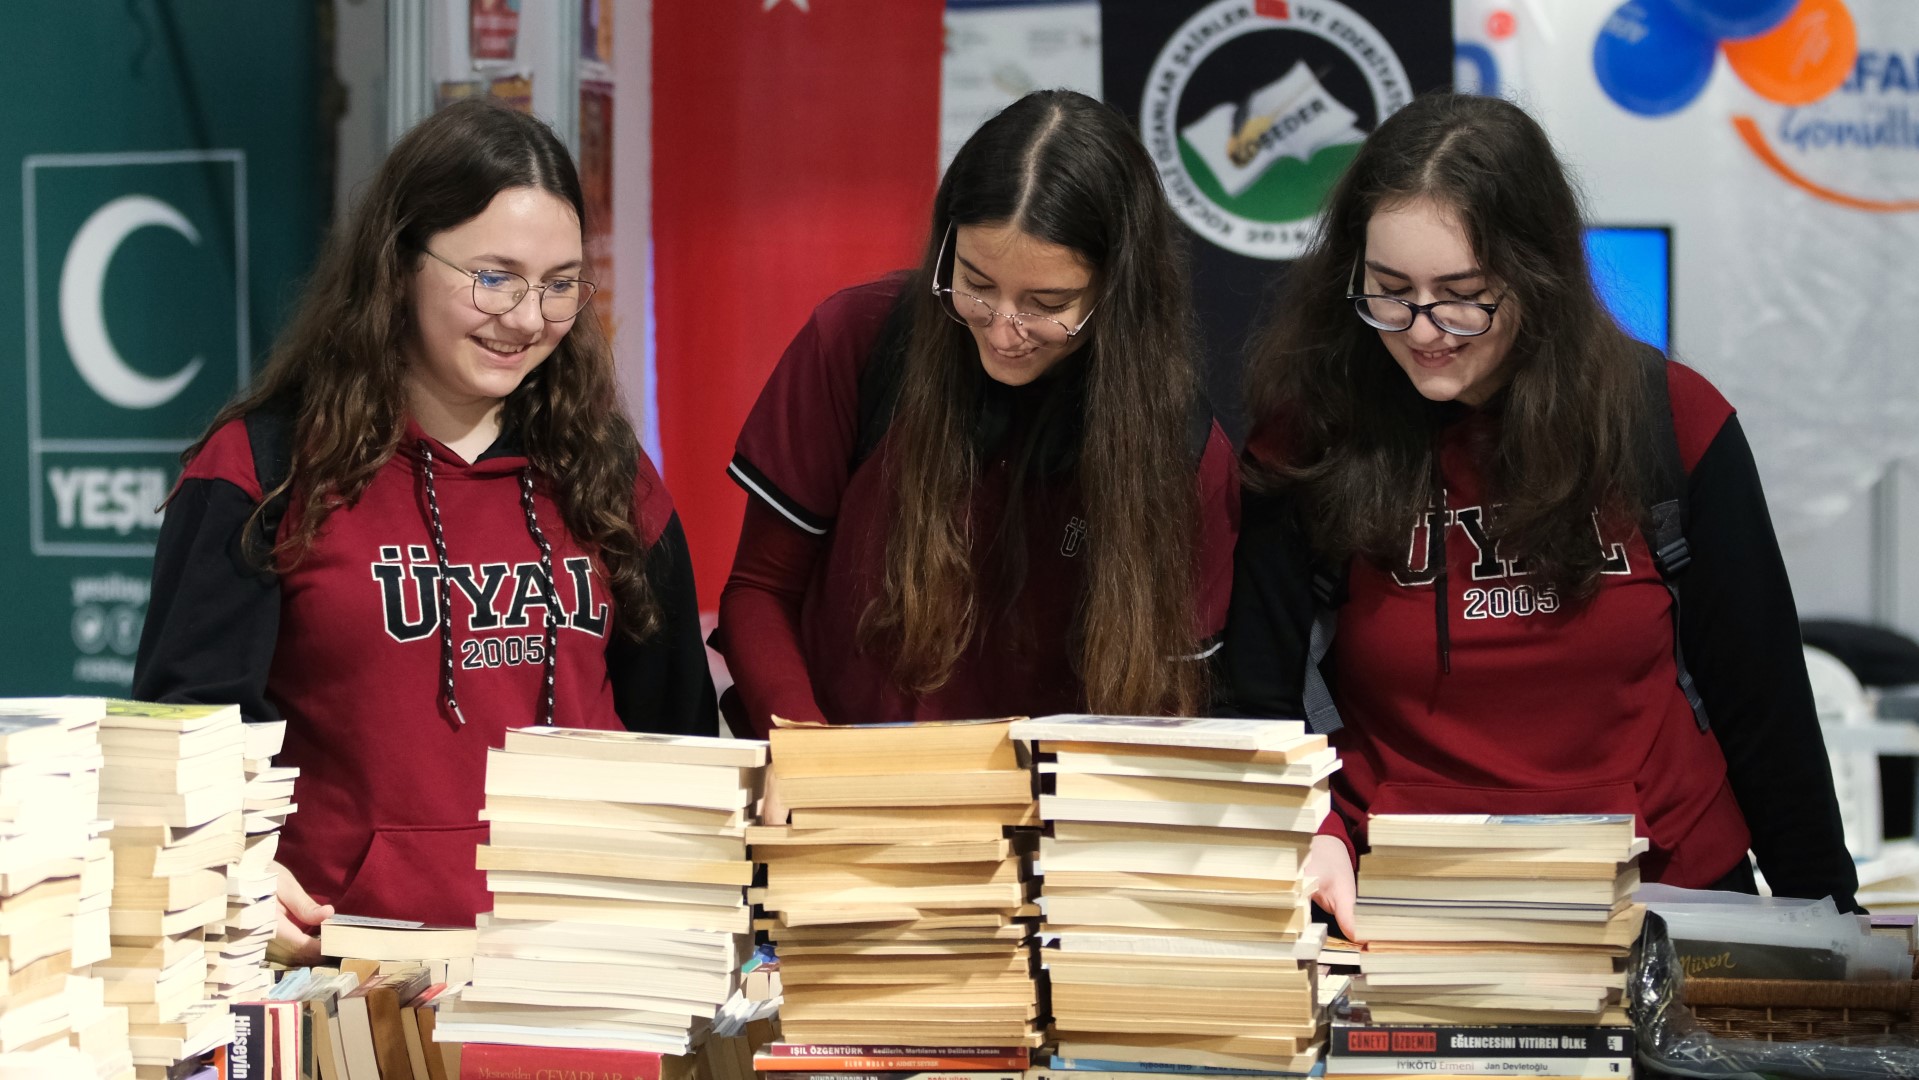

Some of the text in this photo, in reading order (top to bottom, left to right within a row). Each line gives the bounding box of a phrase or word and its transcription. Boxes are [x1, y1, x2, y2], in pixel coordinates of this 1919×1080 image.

[1297, 6, 1324, 24] VE
[371, 544, 609, 643] ÜYAL
[1463, 581, 1560, 620] 2005
[460, 634, 546, 670] 2005
[233, 1015, 251, 1080] Hüseyin
[790, 1046, 808, 1056] IŞIL
[809, 1045, 864, 1055] ÖZGENTÜRK
[1561, 1034, 1587, 1050] ÜLKE
[1439, 1061, 1475, 1071] Ermeni
[1484, 1062, 1501, 1071] Jan
[1502, 1061, 1549, 1072] Devletoğlu
